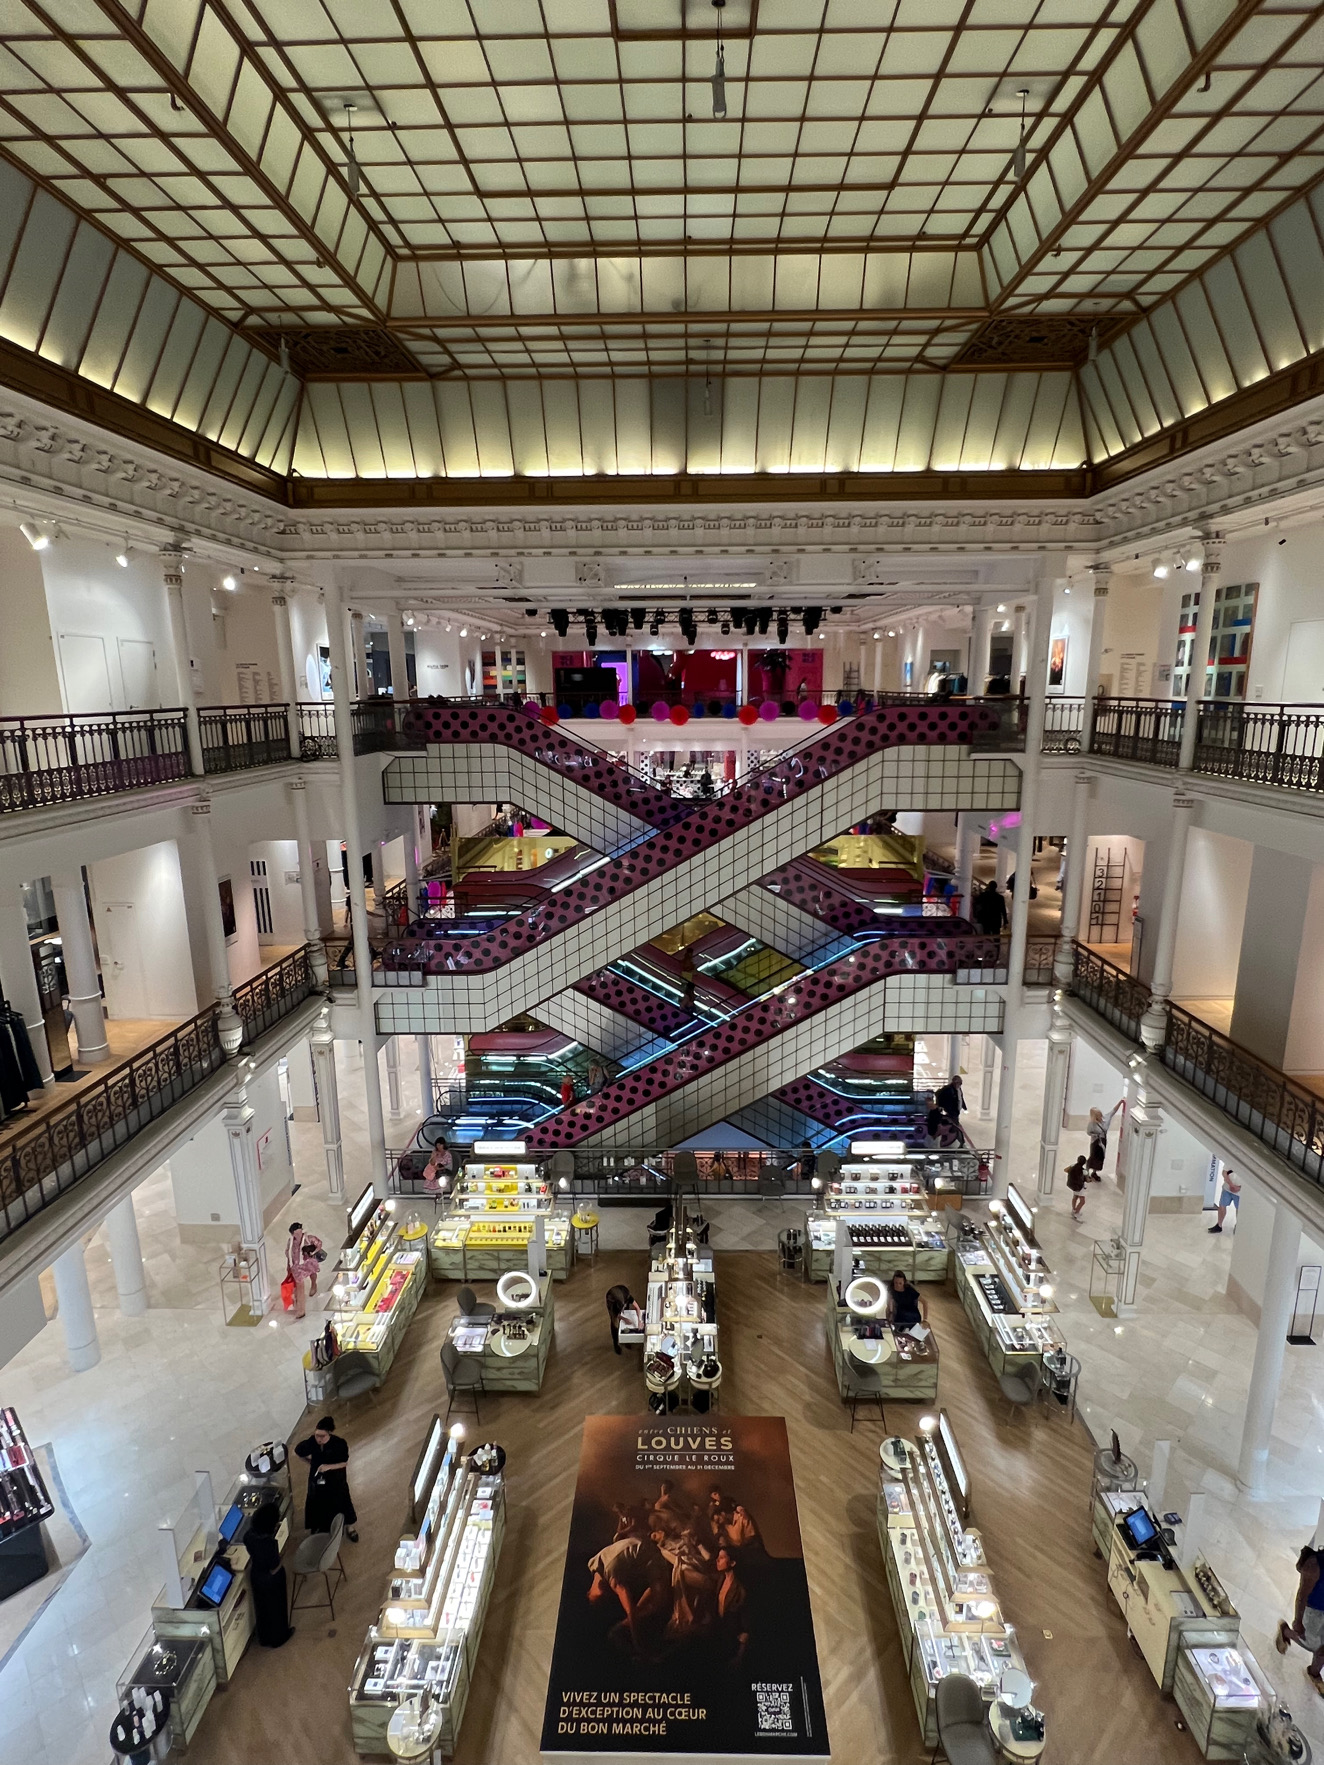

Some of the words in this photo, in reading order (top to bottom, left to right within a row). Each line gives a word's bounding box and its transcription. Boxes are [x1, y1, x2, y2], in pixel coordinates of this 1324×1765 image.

[1097, 868, 1105, 878] 3
[1096, 880, 1104, 890] 2
[667, 1426, 718, 1435] CHIENS
[637, 1436, 733, 1450] LOUVES
[751, 1681, 793, 1692] RÉSERVEZ
[562, 1691, 598, 1703] VIVEZ
[601, 1692, 620, 1704] UN
[622, 1692, 692, 1704] SPECTACLE
[559, 1706, 643, 1719] D'EXCEPTION
[645, 1708, 663, 1720] AU
[666, 1708, 707, 1720] CŒUR
[557, 1721, 577, 1734] DU
[580, 1722, 608, 1735] BON
[611, 1720, 668, 1735] MARCHÉ
